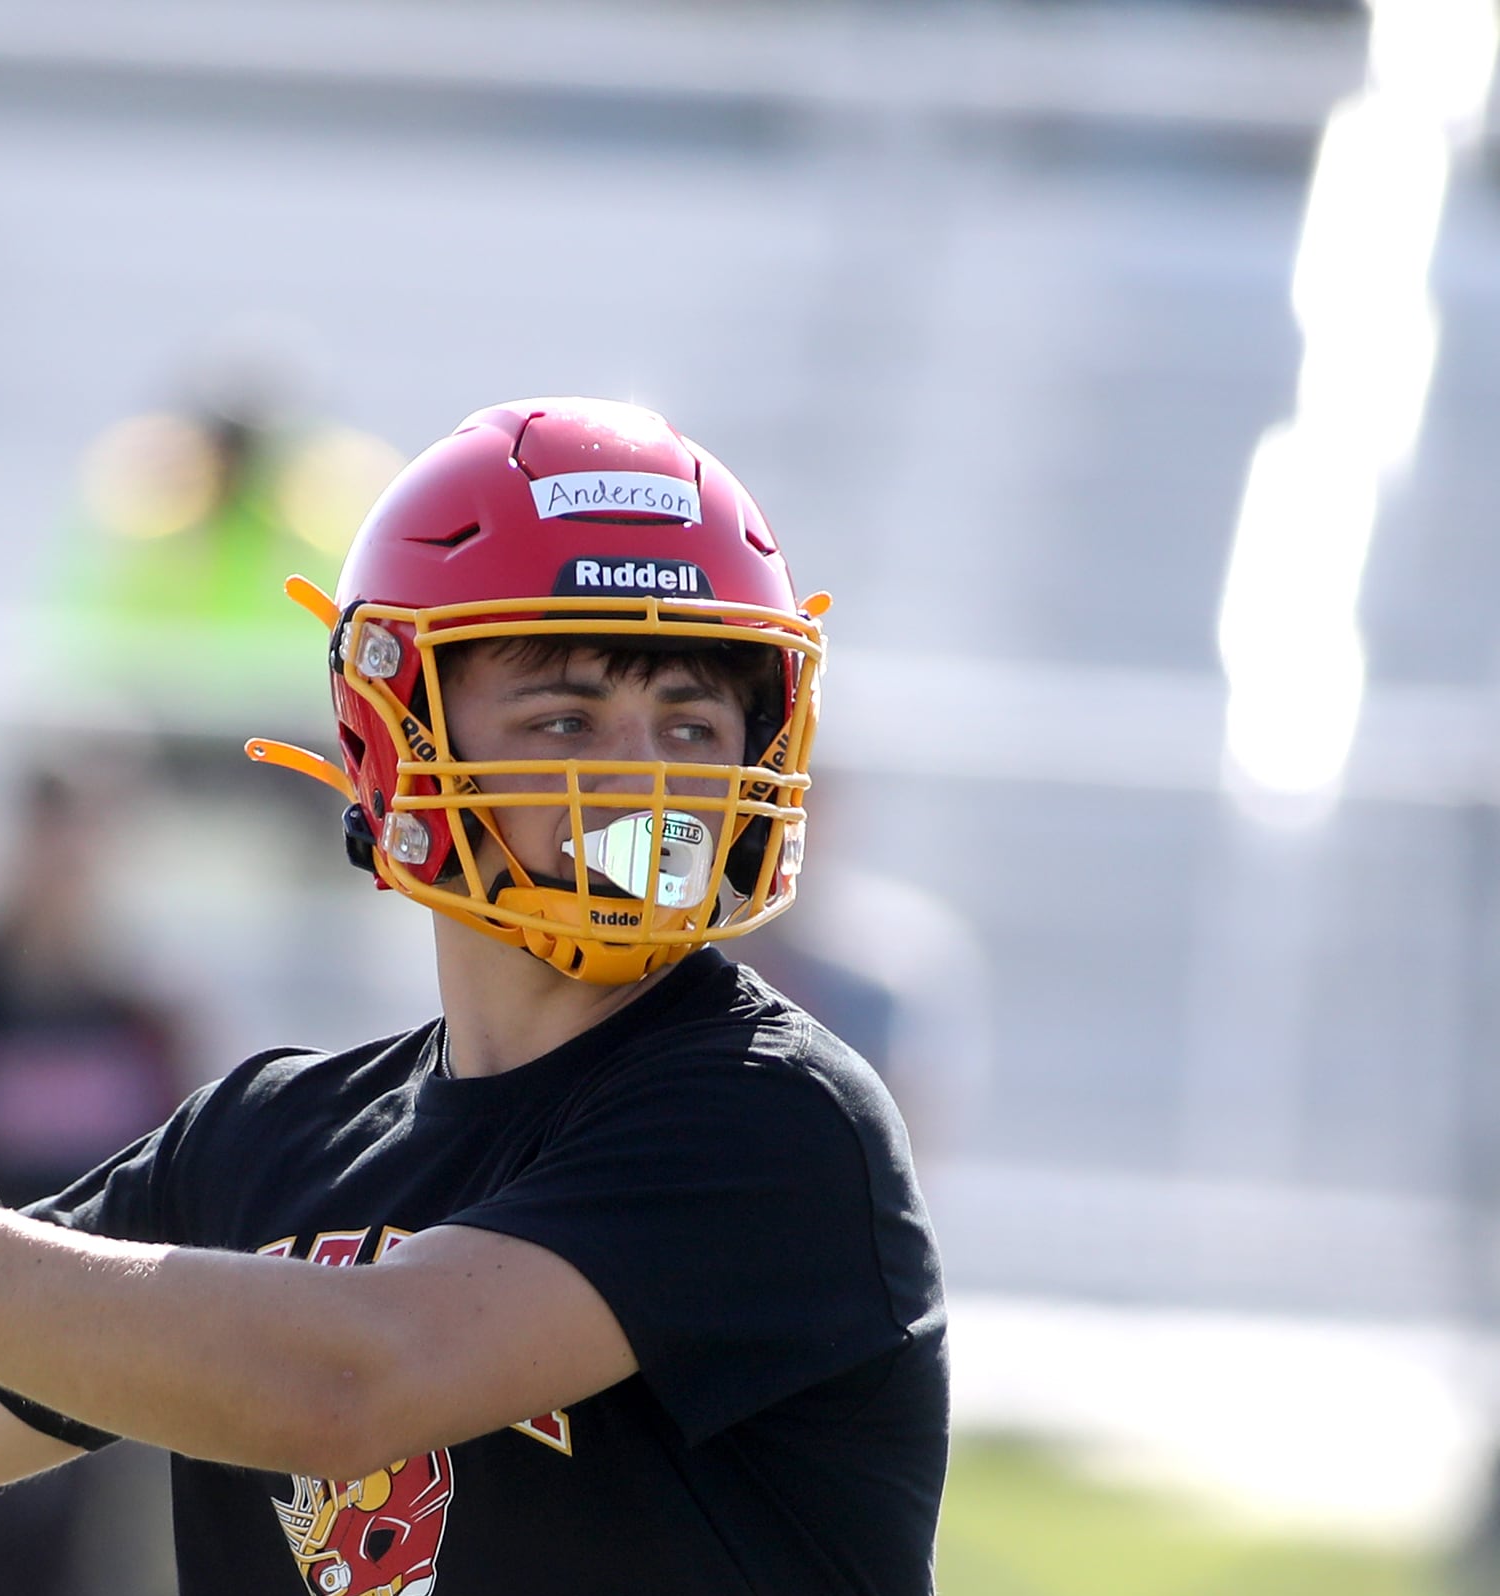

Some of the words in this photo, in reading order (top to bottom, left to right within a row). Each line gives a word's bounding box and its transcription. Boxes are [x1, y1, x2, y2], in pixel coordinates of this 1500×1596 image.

[548, 479, 692, 517] Anderson
[576, 560, 698, 592] Riddell
[662, 822, 700, 841] ATTLE
[590, 910, 643, 926] Ridde
